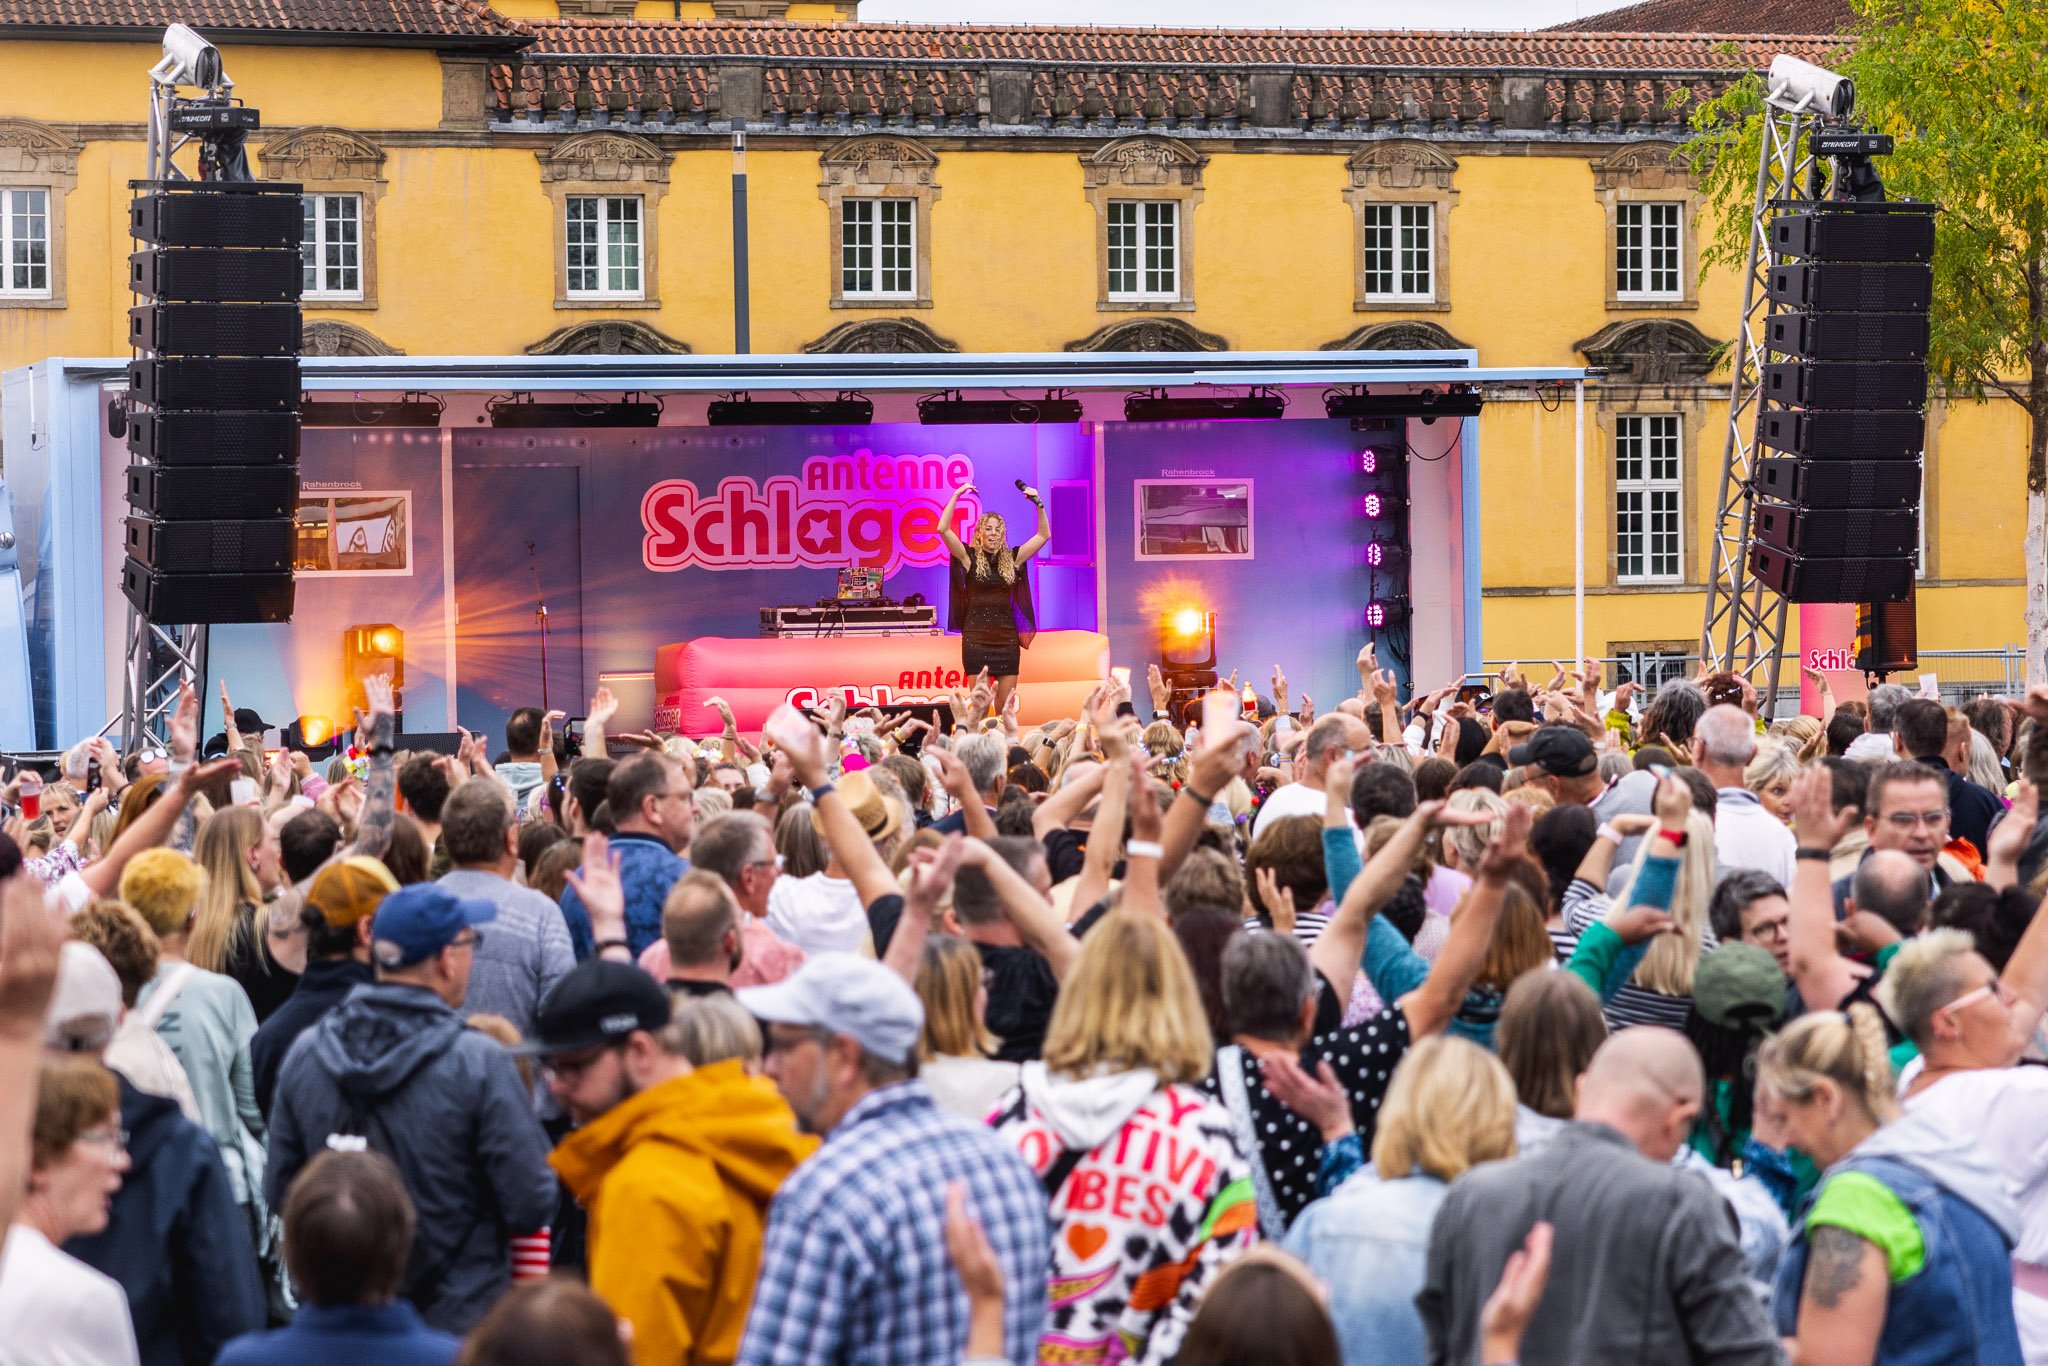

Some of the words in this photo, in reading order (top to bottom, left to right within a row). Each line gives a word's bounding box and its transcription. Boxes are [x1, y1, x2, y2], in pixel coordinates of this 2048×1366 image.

[1161, 469, 1215, 477] Rahenbrock
[302, 481, 362, 490] Rahenbrock
[653, 489, 969, 568] Schlager
[1810, 649, 1857, 671] Schl
